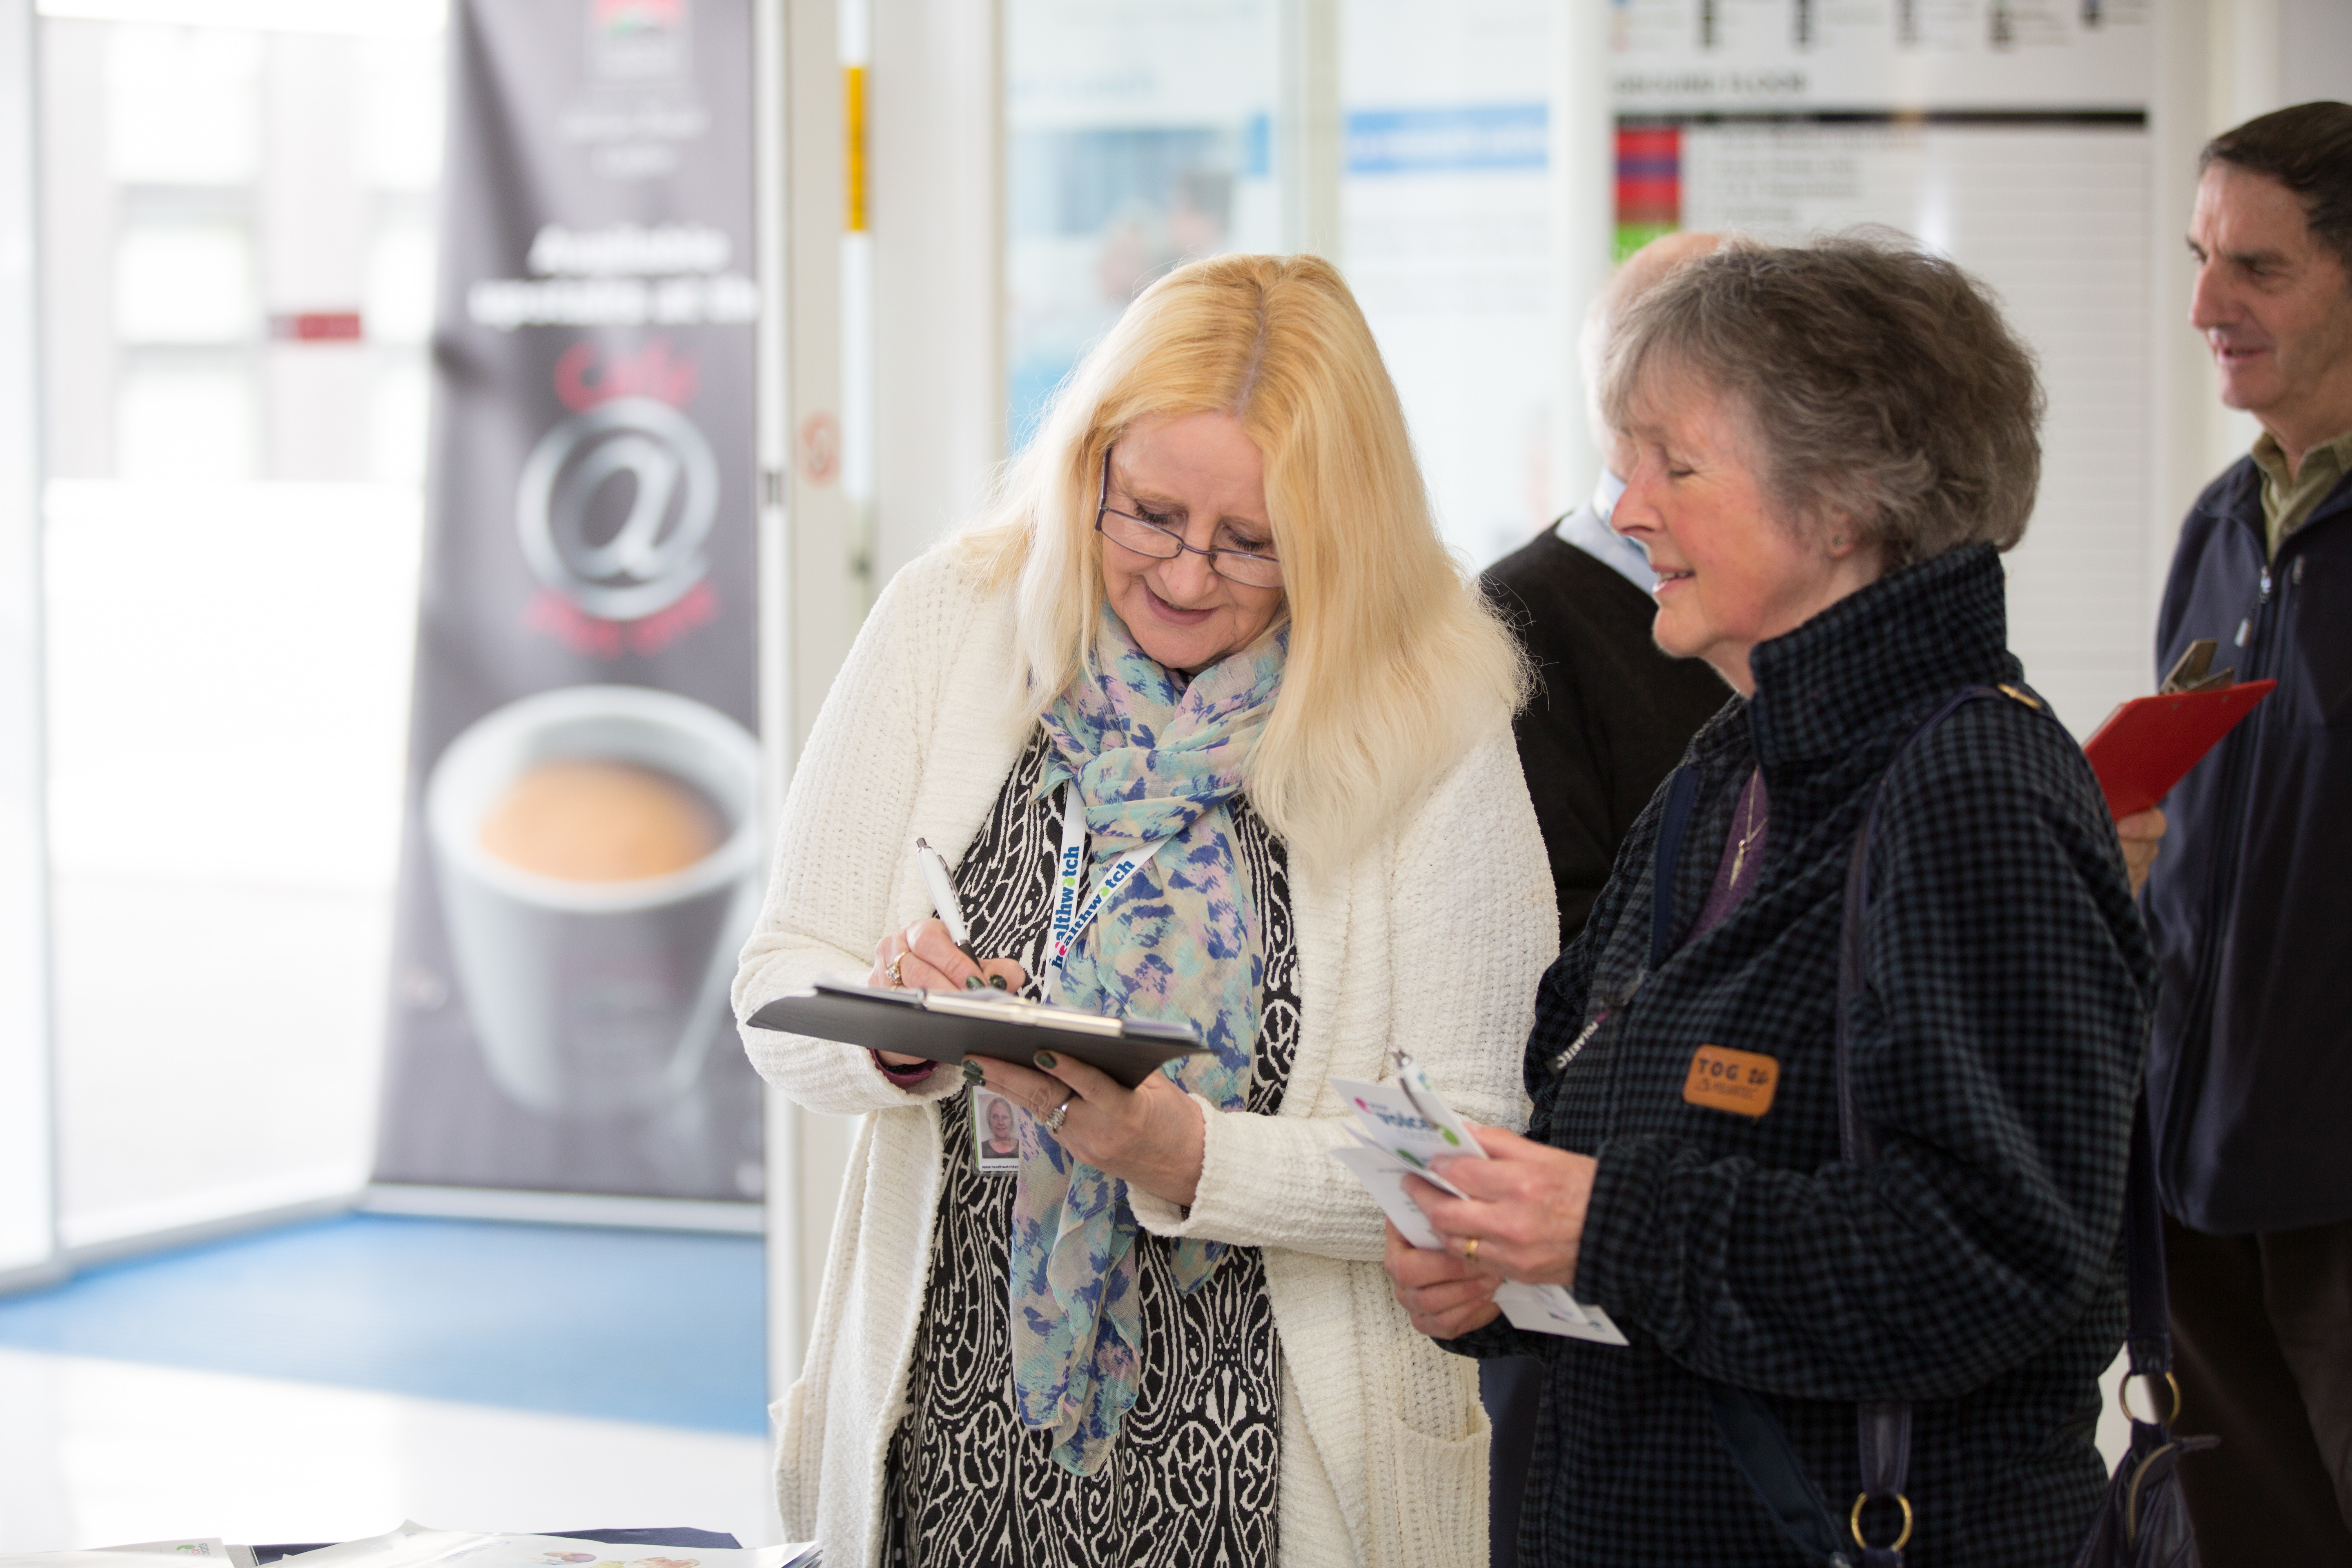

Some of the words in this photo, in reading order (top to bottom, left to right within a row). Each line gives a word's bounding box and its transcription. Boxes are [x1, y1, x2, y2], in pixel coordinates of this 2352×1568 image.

[1049, 846, 1080, 964] althwatch
[1051, 859, 1135, 970] healthwatch
[1698, 1058, 1740, 1081] TOG
